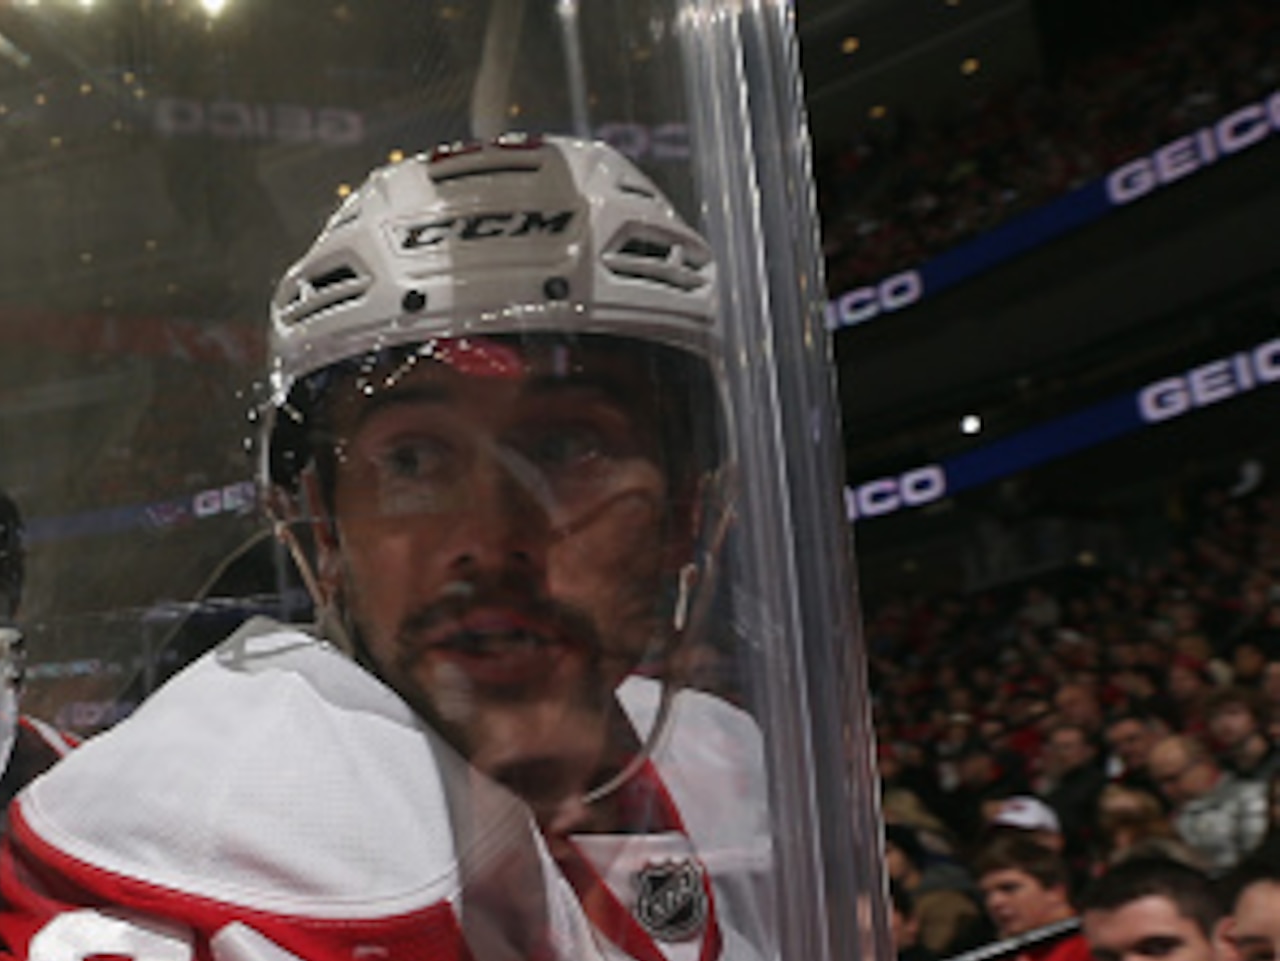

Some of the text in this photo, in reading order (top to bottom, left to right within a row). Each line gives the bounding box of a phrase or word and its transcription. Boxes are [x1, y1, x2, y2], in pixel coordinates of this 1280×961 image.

[1106, 90, 1280, 205] GEIC
[400, 209, 577, 252] CCM
[823, 268, 923, 330] ICO
[1137, 338, 1280, 423] GEIC
[842, 463, 947, 522] ICO
